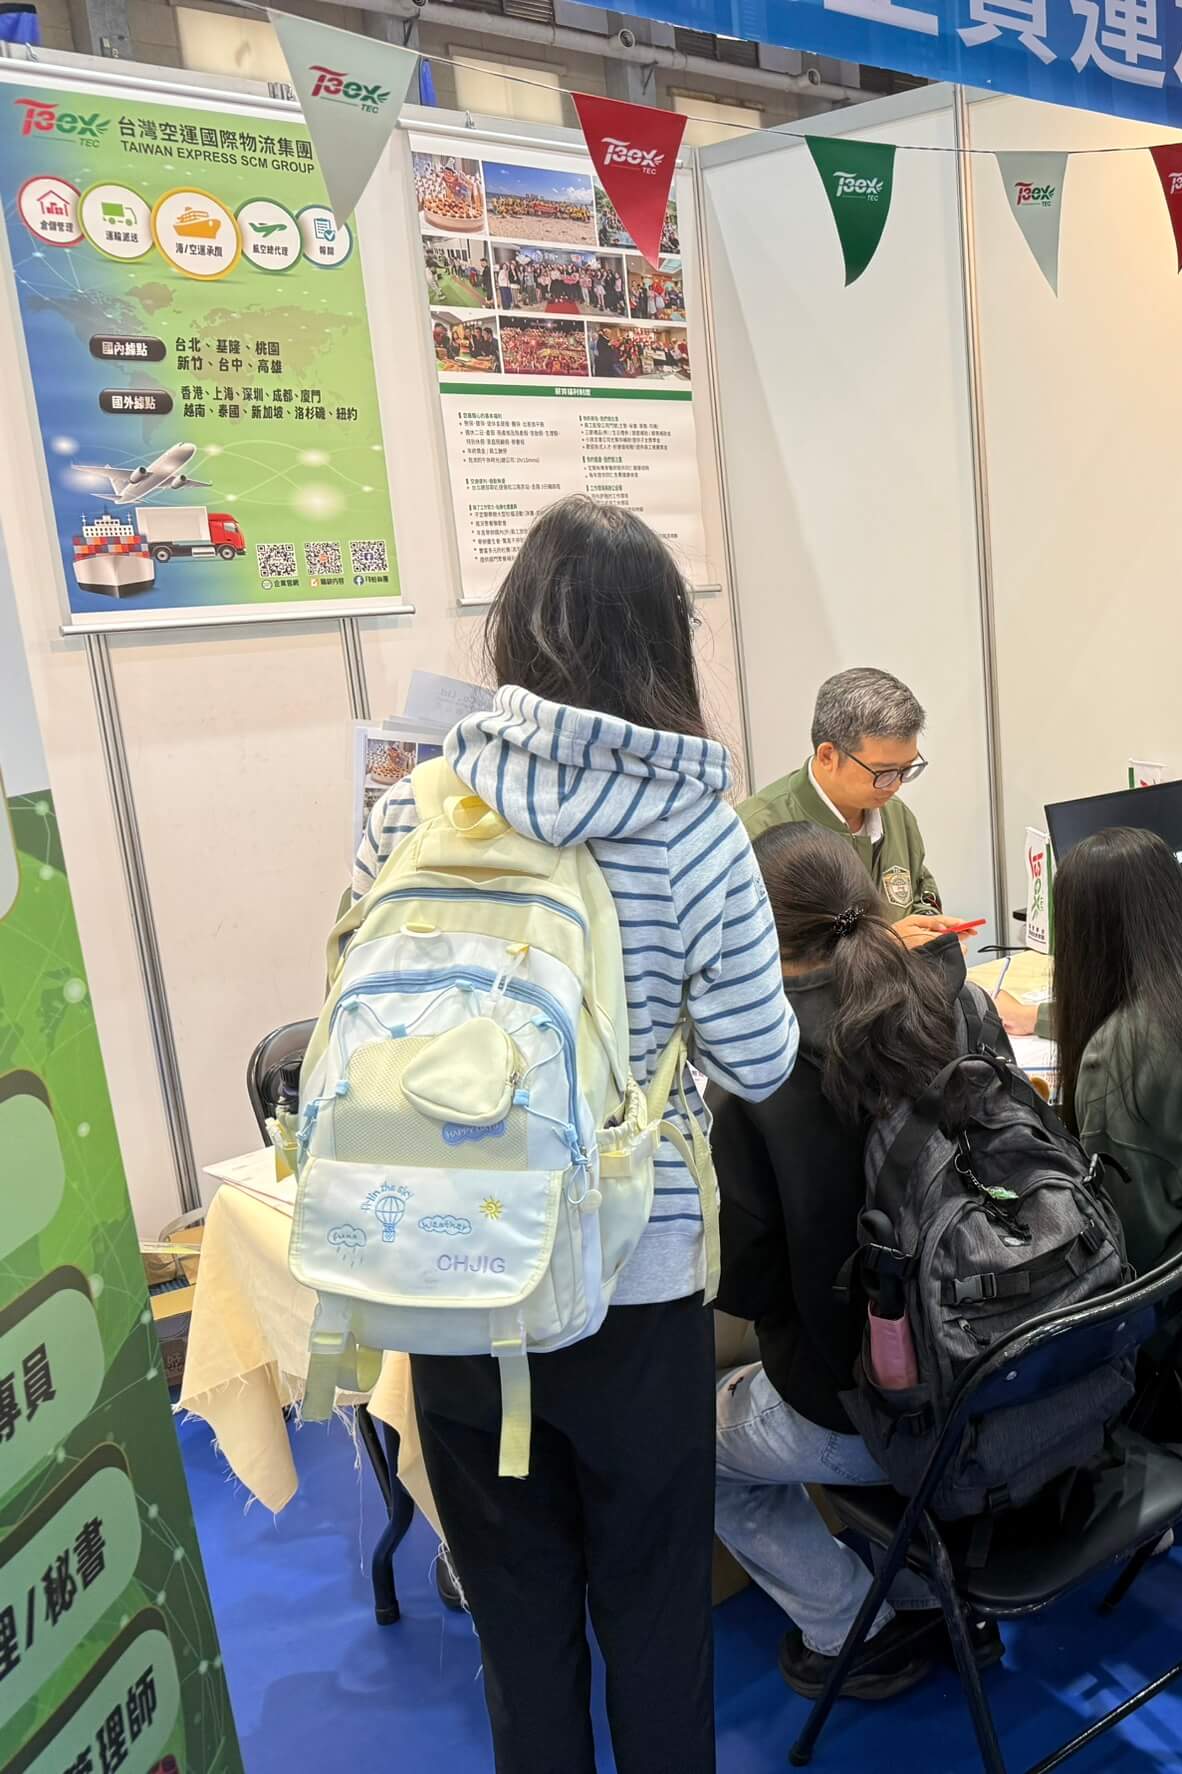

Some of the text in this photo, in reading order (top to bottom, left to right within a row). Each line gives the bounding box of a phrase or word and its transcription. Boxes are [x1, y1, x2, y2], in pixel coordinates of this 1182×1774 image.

[360, 104, 379, 113] TEC
[79, 138, 100, 148] TEC
[118, 116, 313, 160] 台灣空運國際物流集團
[120, 140, 315, 175] TAIWAN EXPRESS SCM GROUP
[642, 167, 657, 175] TEC
[175, 337, 280, 356] 台北、基隆、桃園
[177, 356, 282, 374] 新竹、台中、高雄
[436, 1254, 505, 1274] CHJIG
